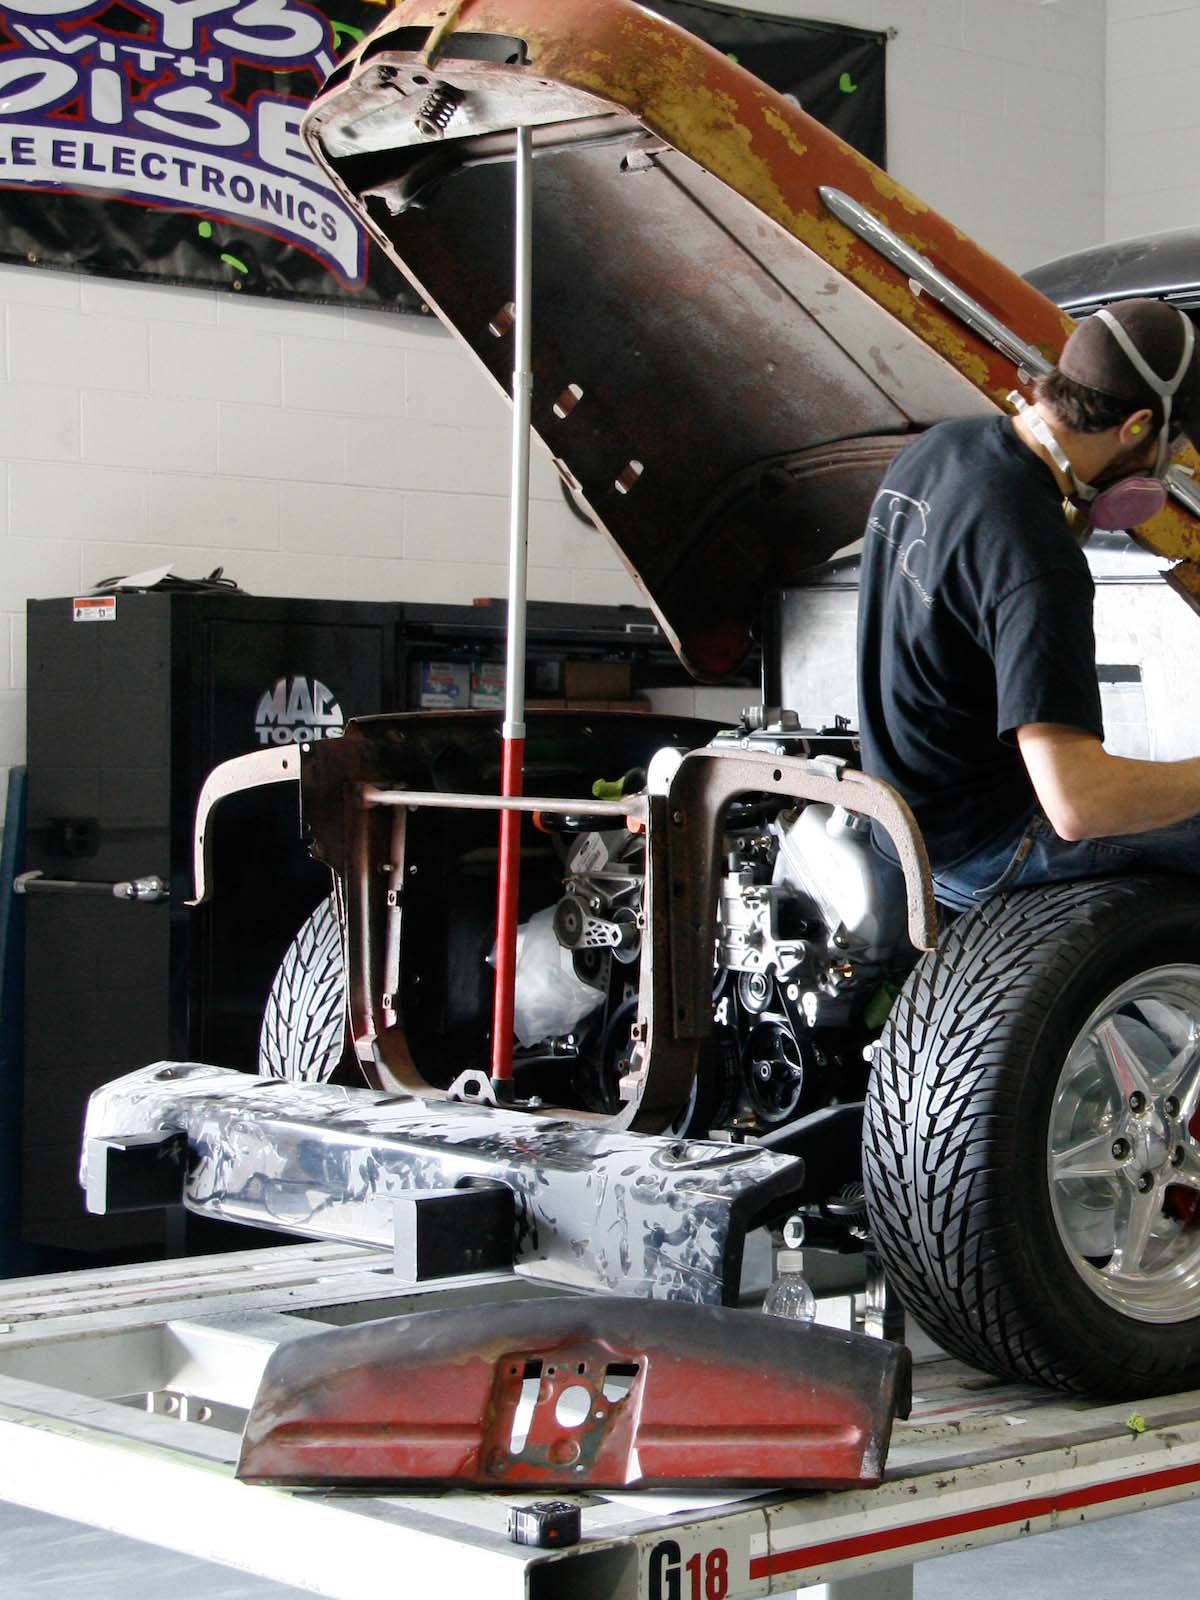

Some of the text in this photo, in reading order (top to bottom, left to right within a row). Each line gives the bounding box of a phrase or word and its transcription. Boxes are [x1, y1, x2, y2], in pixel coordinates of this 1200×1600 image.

[12, 23, 224, 83] WITH
[52, 139, 338, 242] ELECTRONICS
[255, 676, 344, 725] MAC
[255, 726, 345, 744] TOOLS
